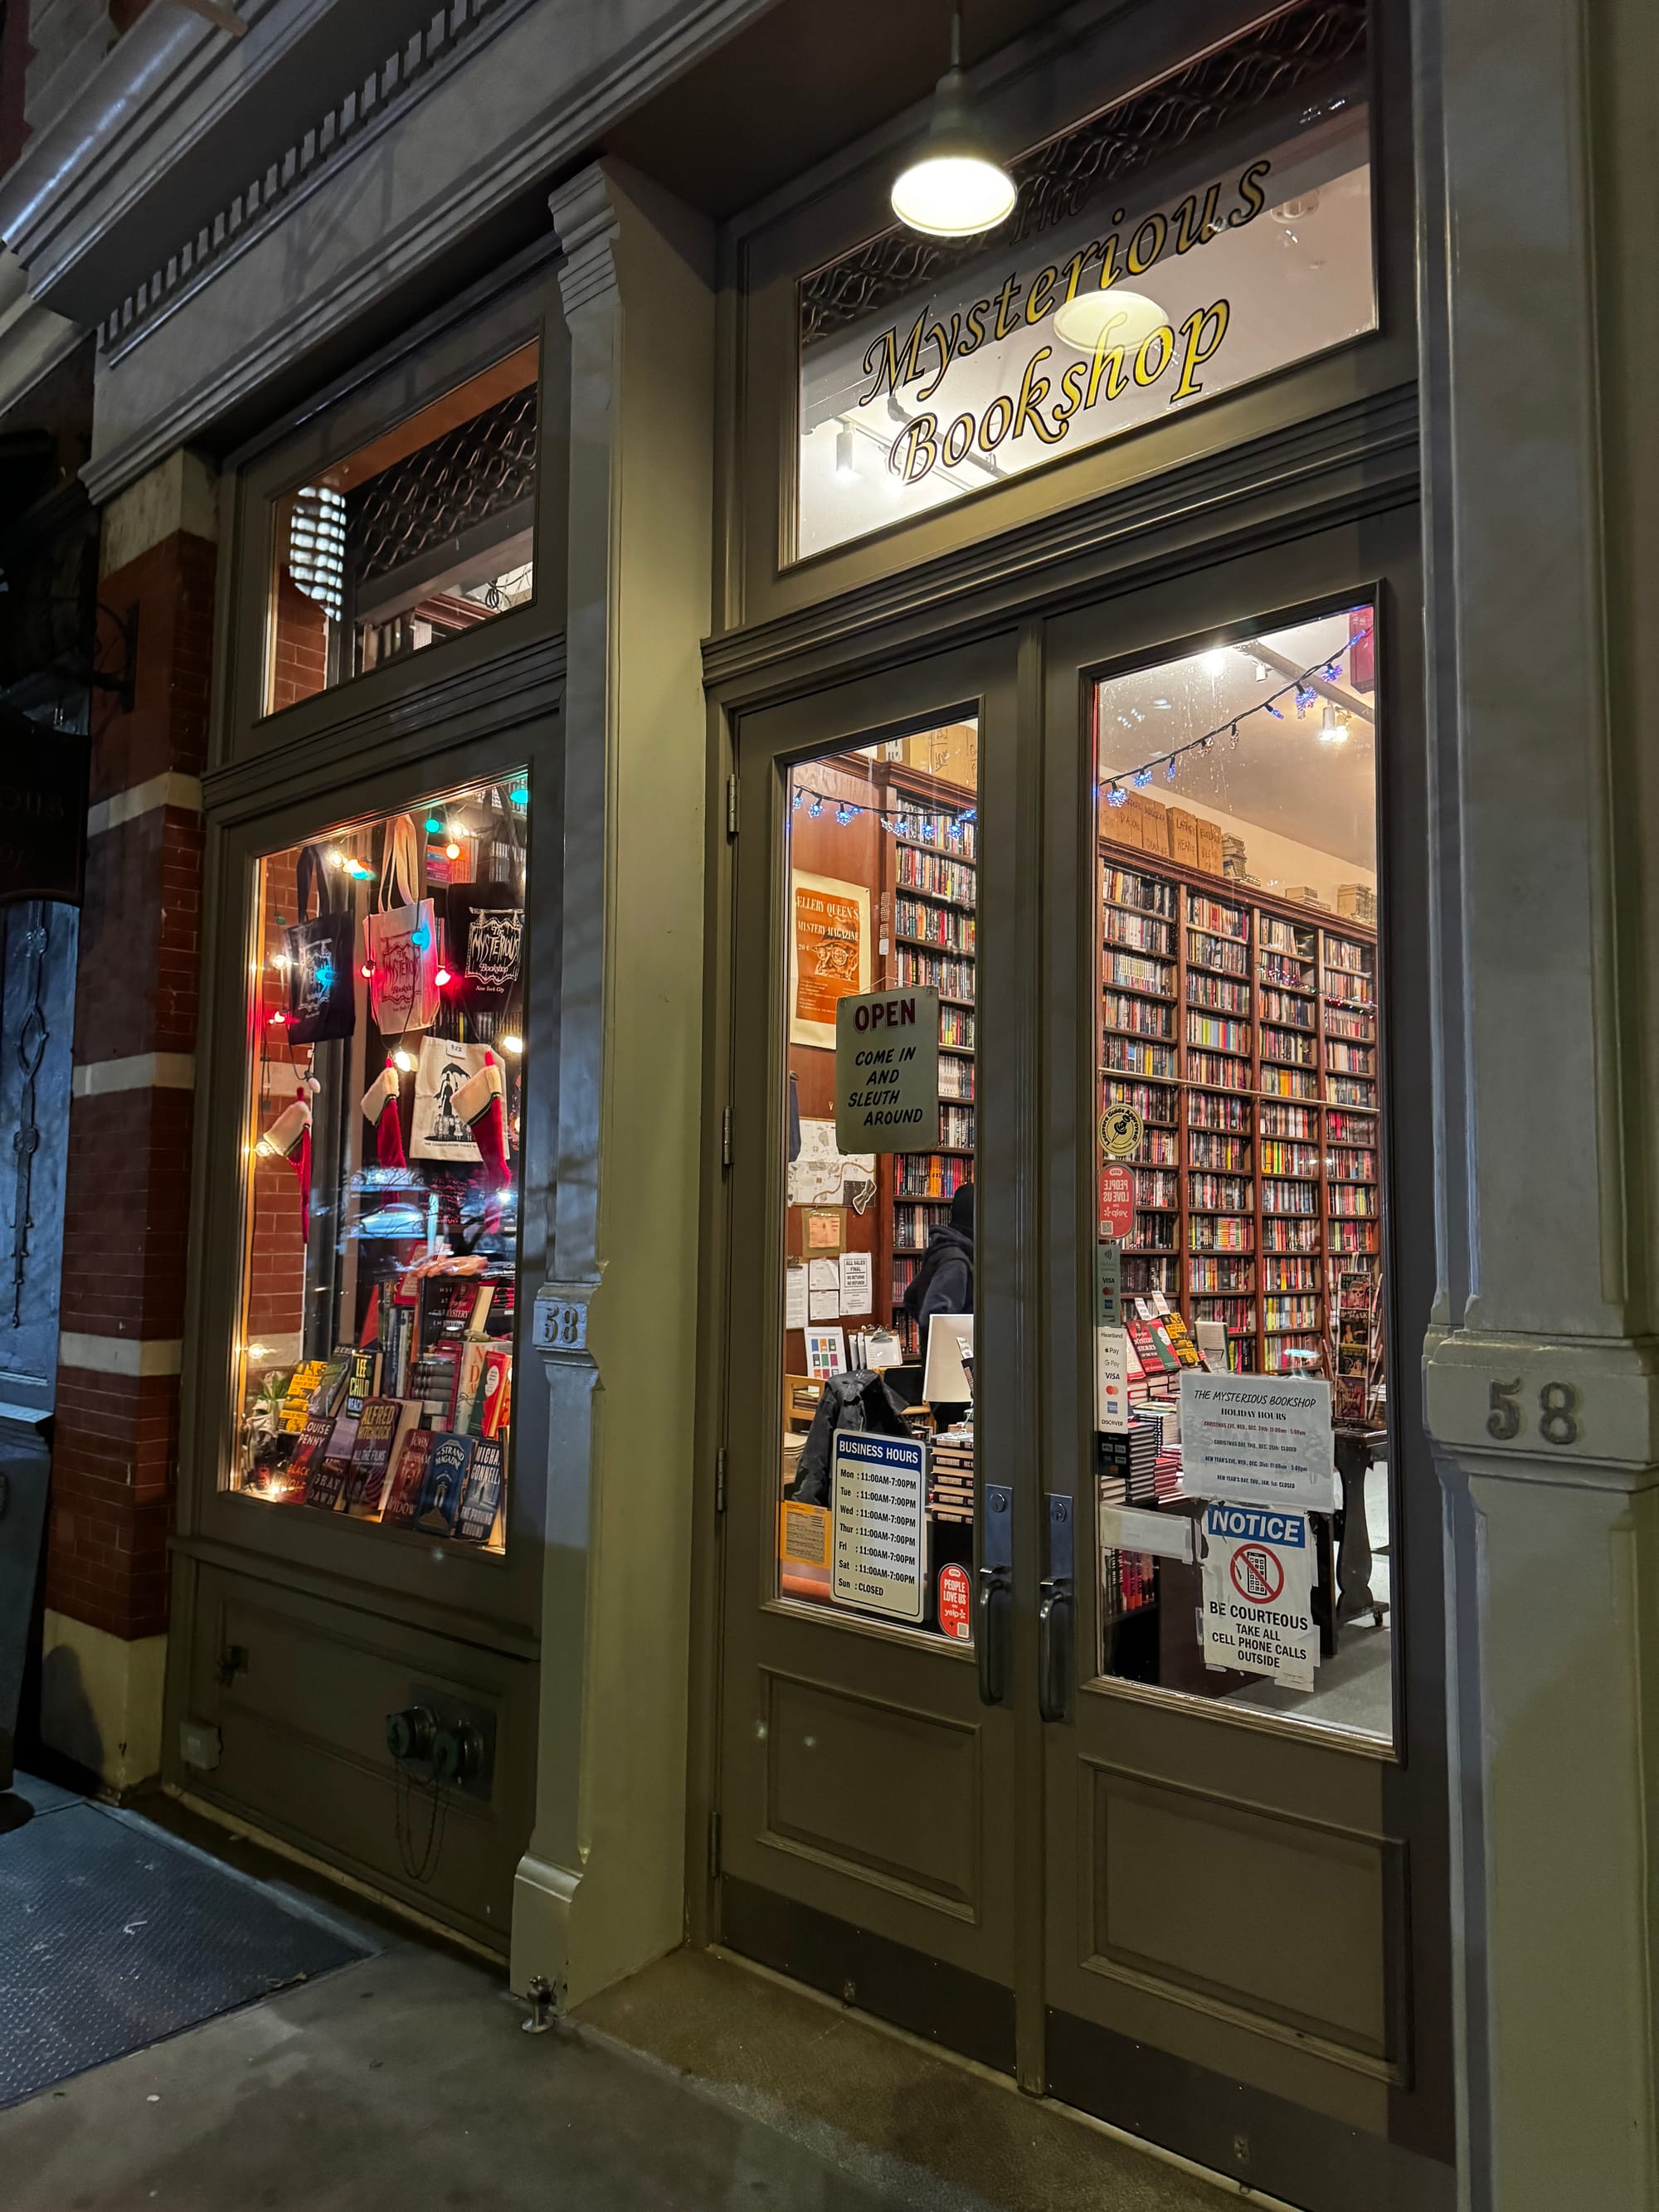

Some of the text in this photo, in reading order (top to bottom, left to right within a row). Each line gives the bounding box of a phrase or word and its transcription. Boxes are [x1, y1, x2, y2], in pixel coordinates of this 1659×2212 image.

[859, 160, 1271, 406] Mysterious
[888, 299, 1230, 486] Bookshop
[796, 897, 859, 921] ELLERY QUEEN'S
[798, 921, 859, 941] MYSTERY MAGAZINE
[472, 934, 519, 965] MYSTERIOUS
[479, 963, 508, 974] Bookshop
[855, 998, 916, 1032] OPEN
[855, 1047, 916, 1066] COME IN
[866, 1069, 899, 1086] AND
[848, 1090, 901, 1108] SLEUTH
[864, 1109, 923, 1126] AROUND
[1107, 1108, 1125, 1117] Guide
[544, 1305, 578, 1344] 58
[356, 1359, 367, 1378] LEE
[1105, 1372, 1121, 1380] VISA
[349, 1377, 370, 1398] CHILD
[1194, 1389, 1316, 1408] THE MYSTERIOUS BOOKSHOP
[361, 1405, 396, 1426] ALFRED
[1221, 1408, 1287, 1421] HOLIDAY HOURS
[1486, 1377, 1578, 1445] 58
[303, 1422, 331, 1435] OUISE
[357, 1426, 392, 1441] HITCHCOCK
[298, 1433, 325, 1447] PENNY
[411, 1432, 430, 1447] JOHN
[353, 1451, 363, 1461] ALL
[371, 1451, 387, 1461] FILMS
[441, 1445, 465, 1461] STRAND
[839, 1441, 918, 1464] BUSINESS HOURS
[435, 1456, 461, 1471] MAGAZINE
[840, 1469, 854, 1479] Mon
[840, 1486, 851, 1496] Tue
[387, 1496, 417, 1515] WIDOW
[840, 1505, 854, 1515] Wed
[839, 1523, 853, 1534] Thur
[1212, 1510, 1301, 1543] NOTICE
[839, 1541, 847, 1551] Fri
[839, 1559, 849, 1570] Sat
[838, 1578, 850, 1588] Sun
[859, 1582, 883, 1596] CLOSED
[944, 1578, 966, 1593] PEOPLE
[943, 1590, 966, 1606] LOVE US
[944, 1608, 959, 1619] yelp
[1209, 1601, 1308, 1631] BE COURTEOUS
[1236, 1623, 1281, 1641] TAKE ALL
[1212, 1632, 1306, 1660] CELL PHONE CALLS
[1238, 1650, 1281, 1668] OUTSIDE
